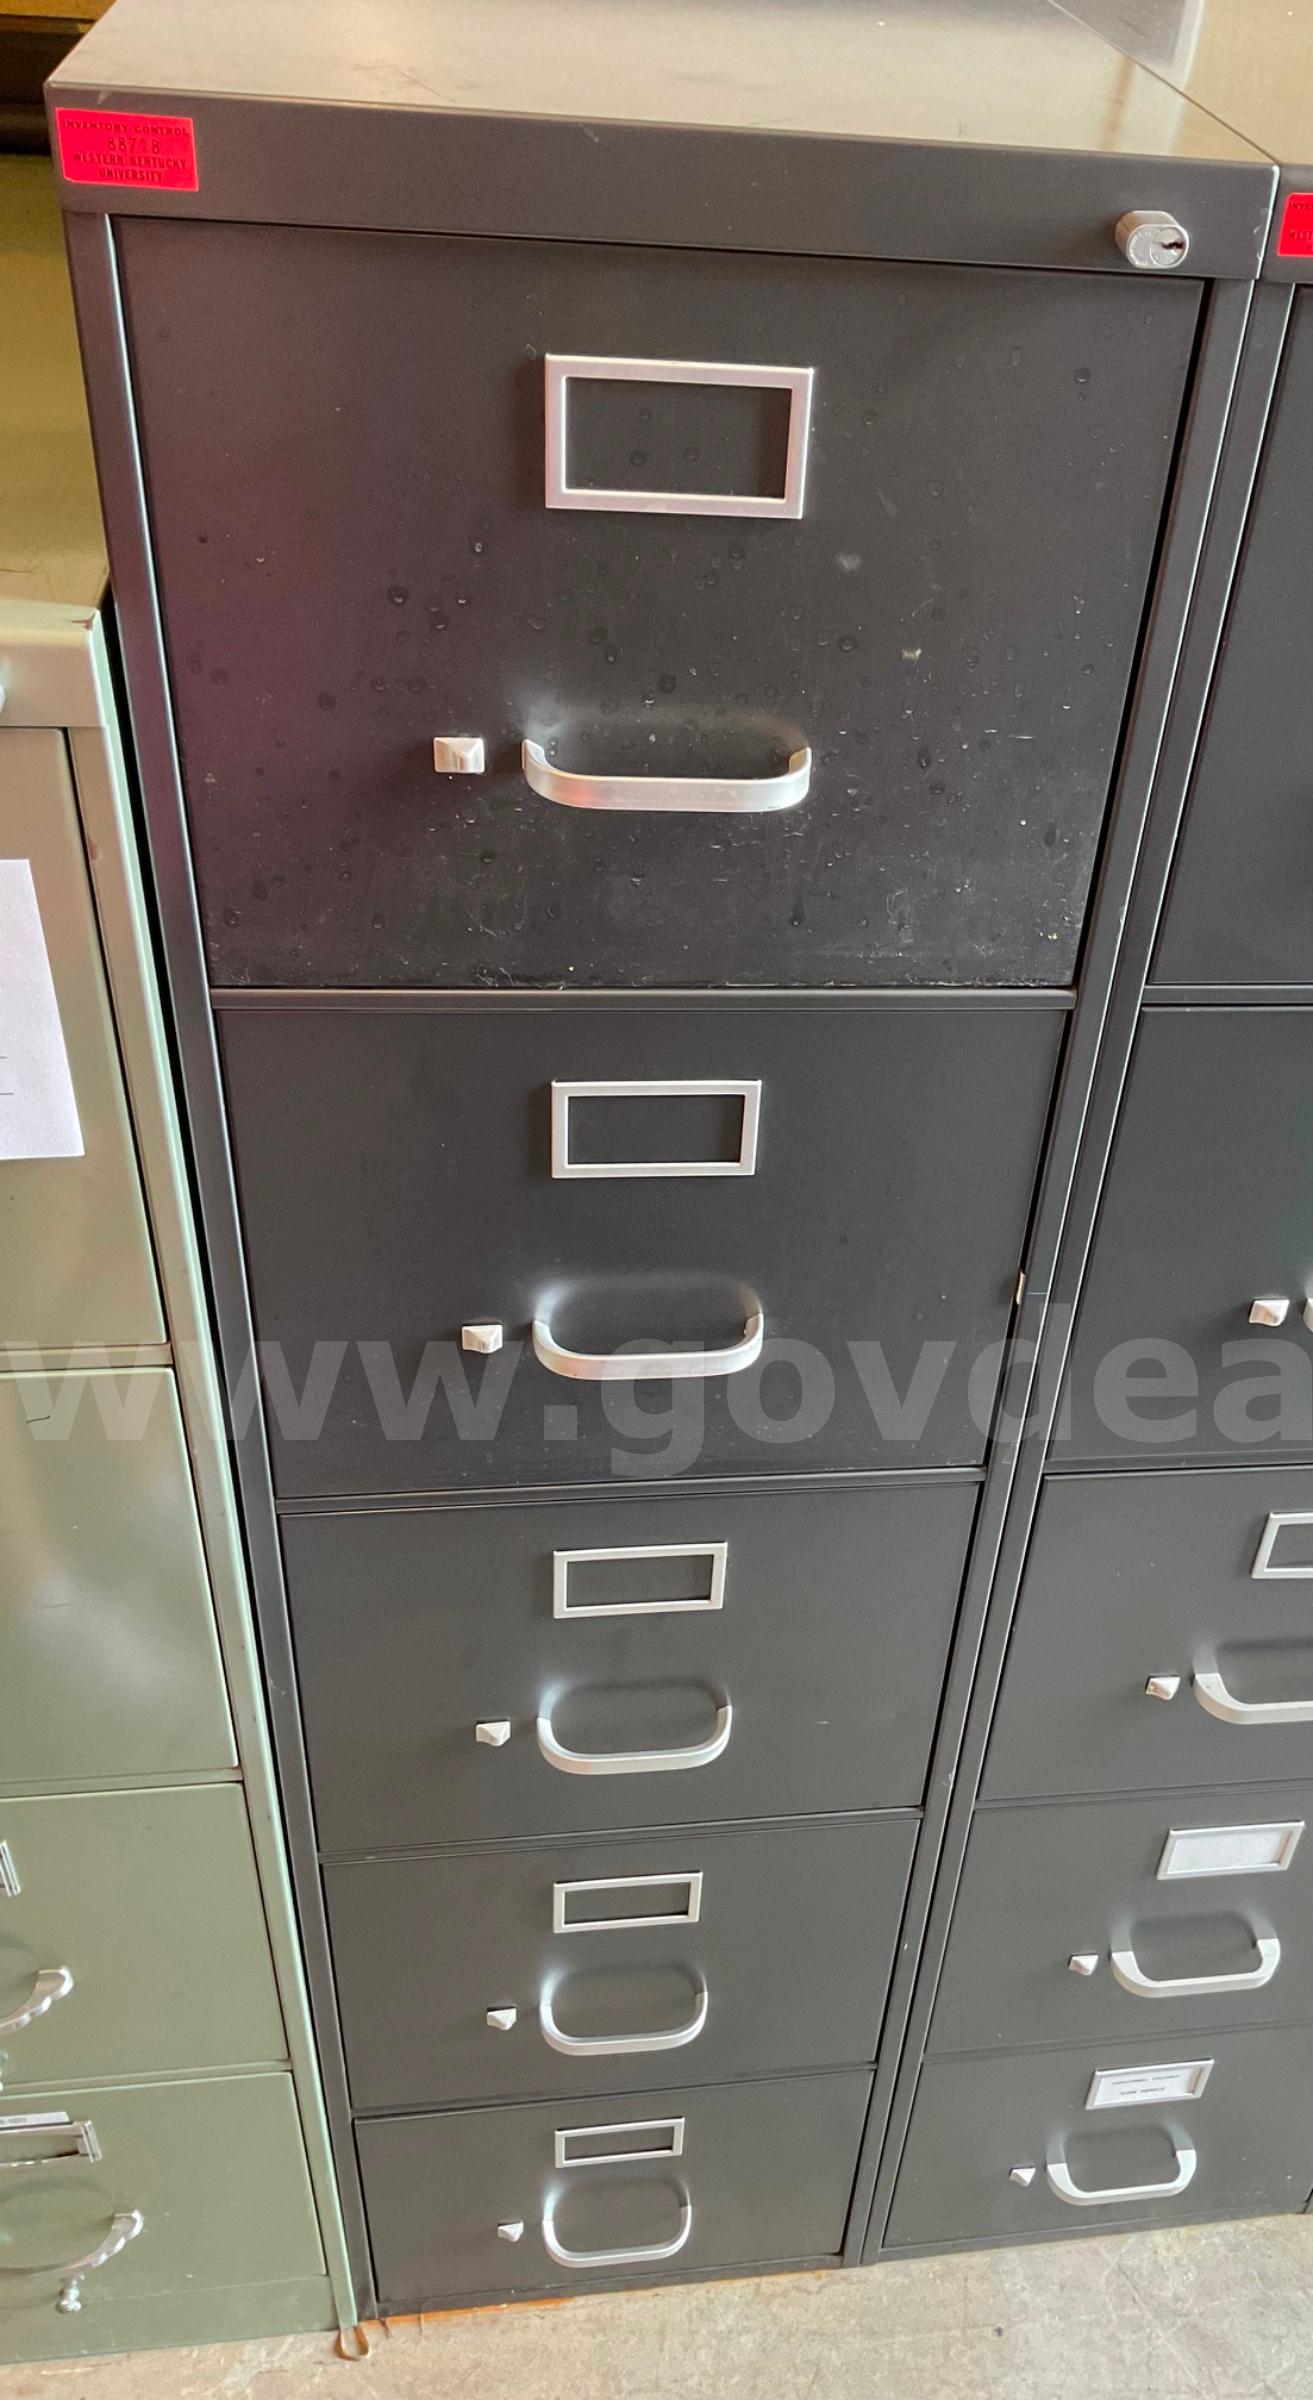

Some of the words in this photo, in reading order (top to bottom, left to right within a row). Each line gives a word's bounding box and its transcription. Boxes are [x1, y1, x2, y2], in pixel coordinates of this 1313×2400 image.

[63, 120, 128, 133] INVENTORY
[134, 124, 189, 137] CONTROL
[73, 151, 124, 166] WESTERN
[129, 155, 186, 169] KENTUCKY
[99, 167, 162, 182] UNIVERSITY
